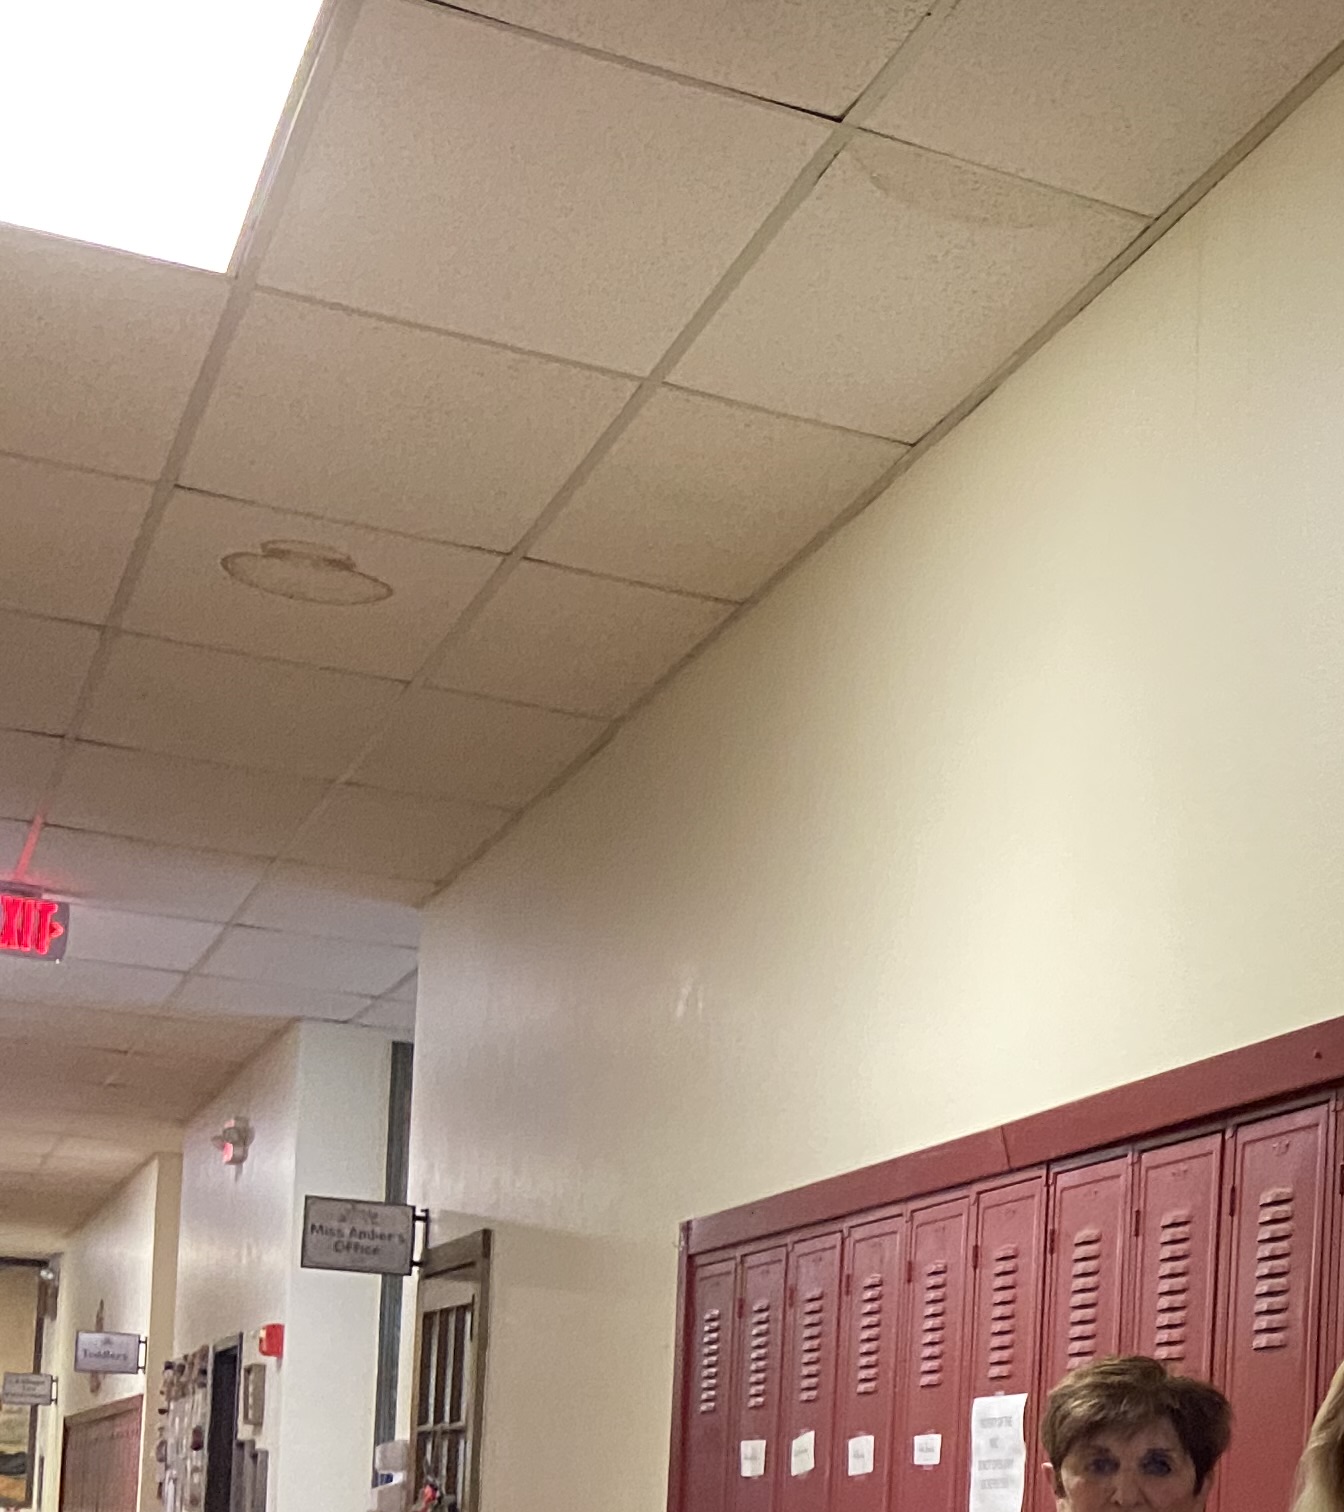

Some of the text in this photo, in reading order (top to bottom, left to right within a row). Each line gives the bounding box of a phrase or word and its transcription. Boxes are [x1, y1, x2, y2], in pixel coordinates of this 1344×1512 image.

[0, 894, 59, 955] XIT
[310, 1223, 345, 1239] Miss
[333, 1240, 381, 1255] Office
